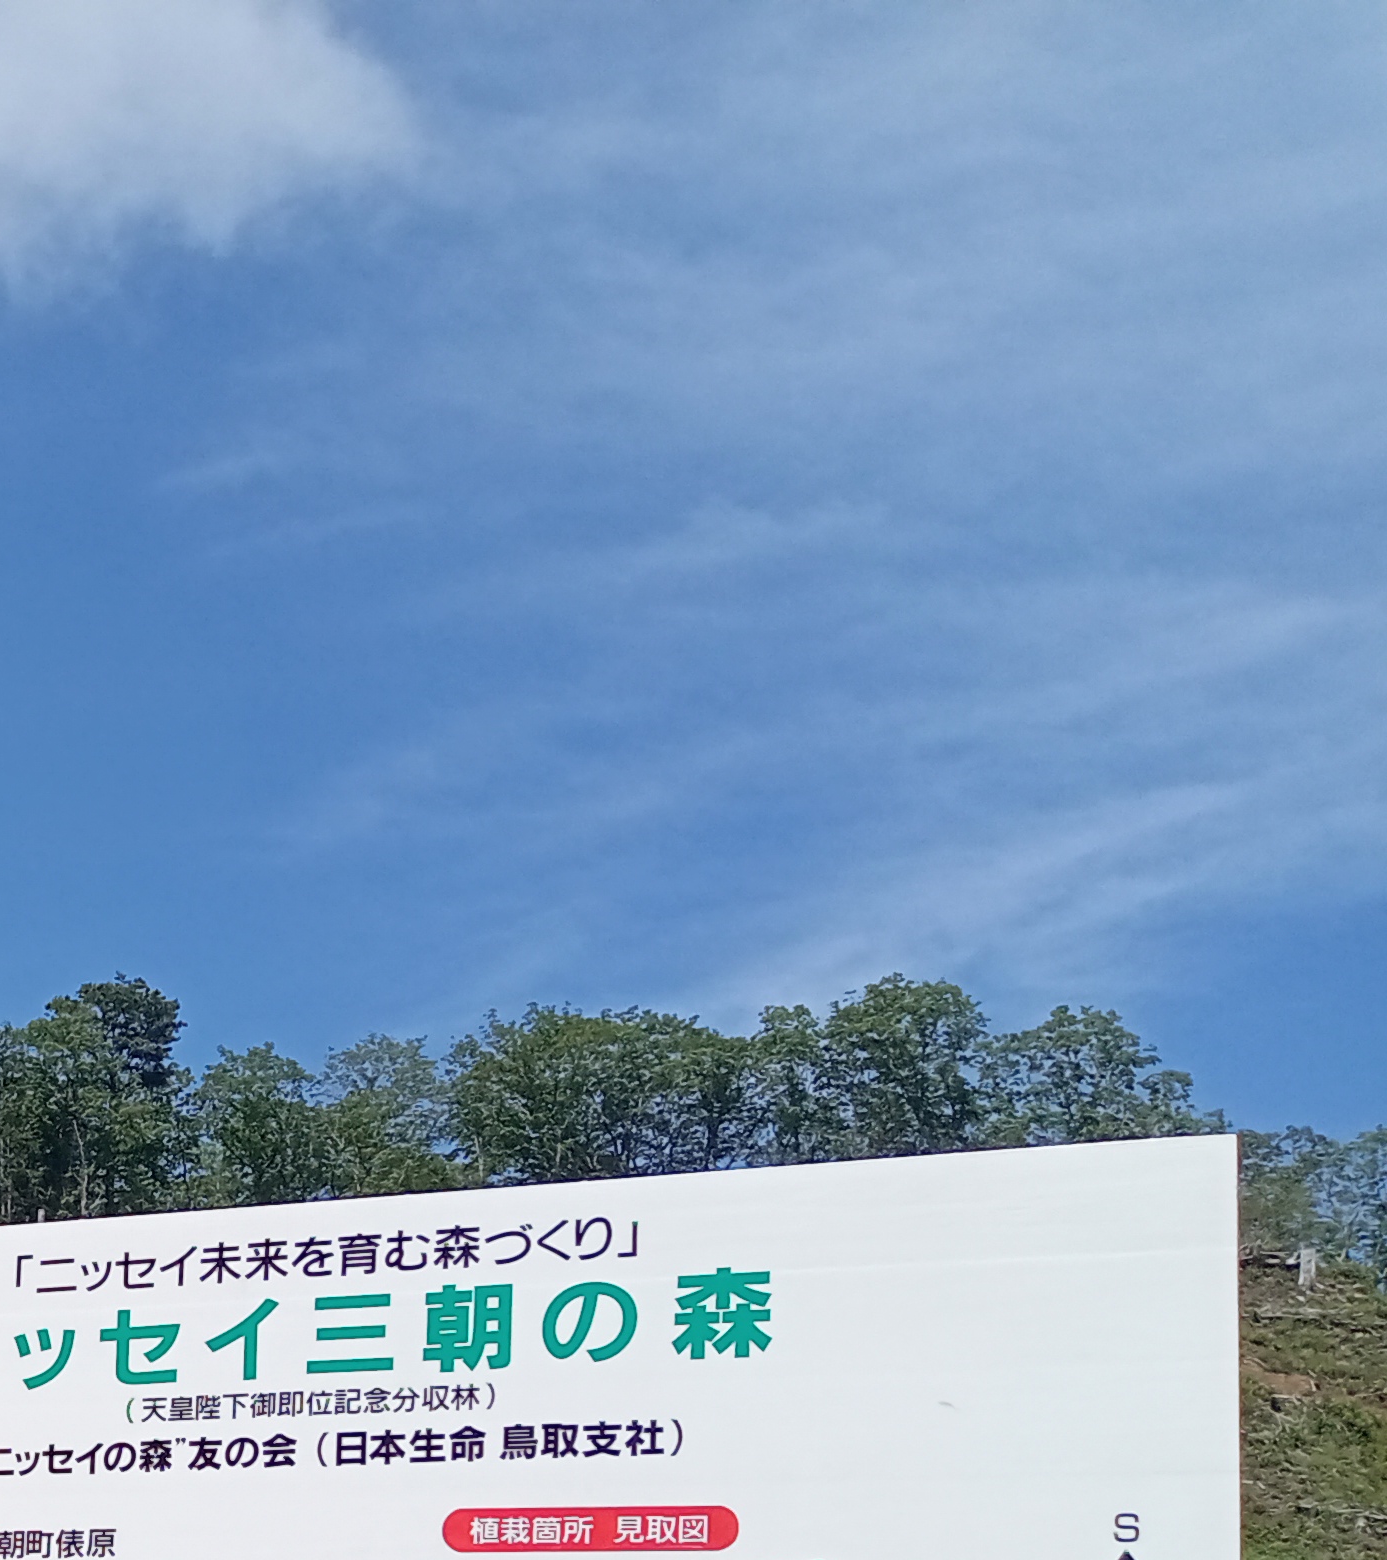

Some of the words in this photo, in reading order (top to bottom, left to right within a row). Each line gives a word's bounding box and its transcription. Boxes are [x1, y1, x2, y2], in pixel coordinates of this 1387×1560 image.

[13, 1215, 640, 1293] 「ニッセイ未来を育む森づくり」
[469, 1516, 594, 1545] 植栽箇所
[613, 1515, 709, 1544] 見取図
[1112, 1512, 1140, 1543] S
